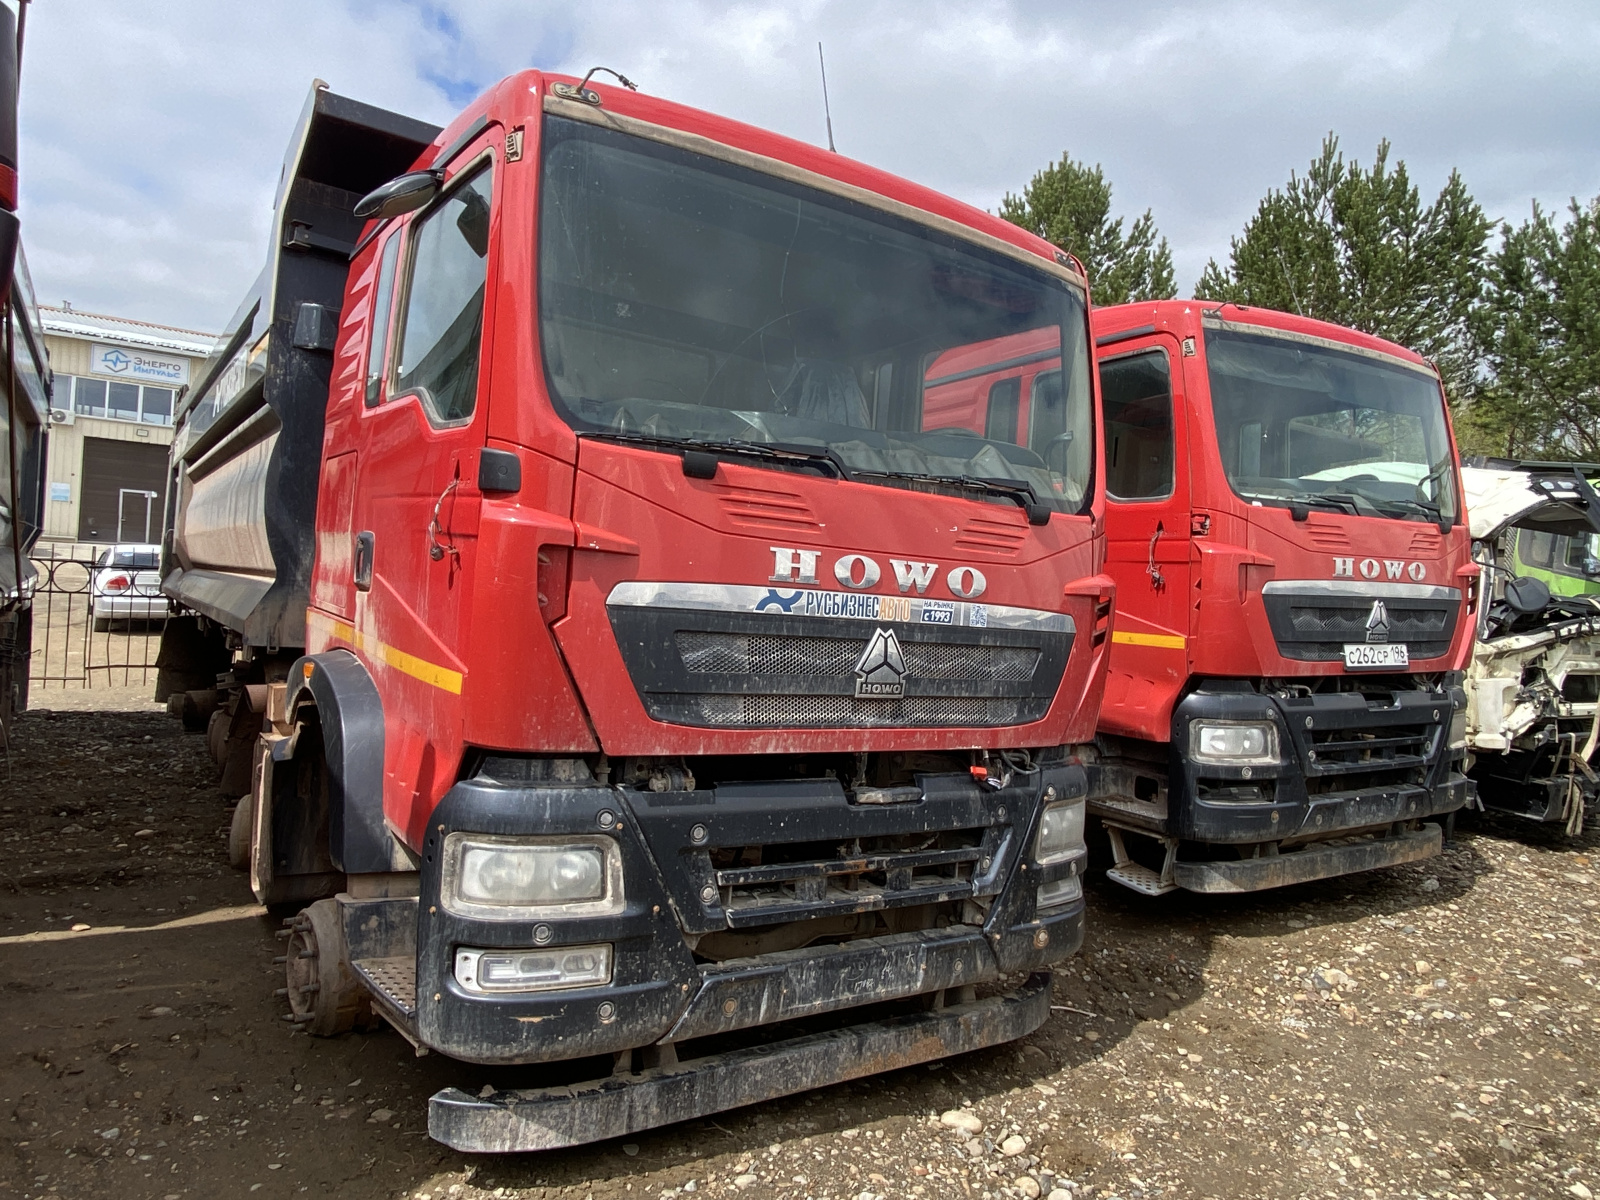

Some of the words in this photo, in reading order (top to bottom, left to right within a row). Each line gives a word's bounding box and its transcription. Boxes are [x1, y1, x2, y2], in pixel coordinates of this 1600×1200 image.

[768, 547, 987, 598] HOWO
[1332, 557, 1426, 581] HOWO
[806, 591, 911, 621] РУСБИЗНЕСАВТО
[933, 601, 954, 609] РЫНКЕ
[930, 611, 951, 622] 1993
[1391, 646, 1405, 659] 196
[862, 684, 901, 694] HOWO
